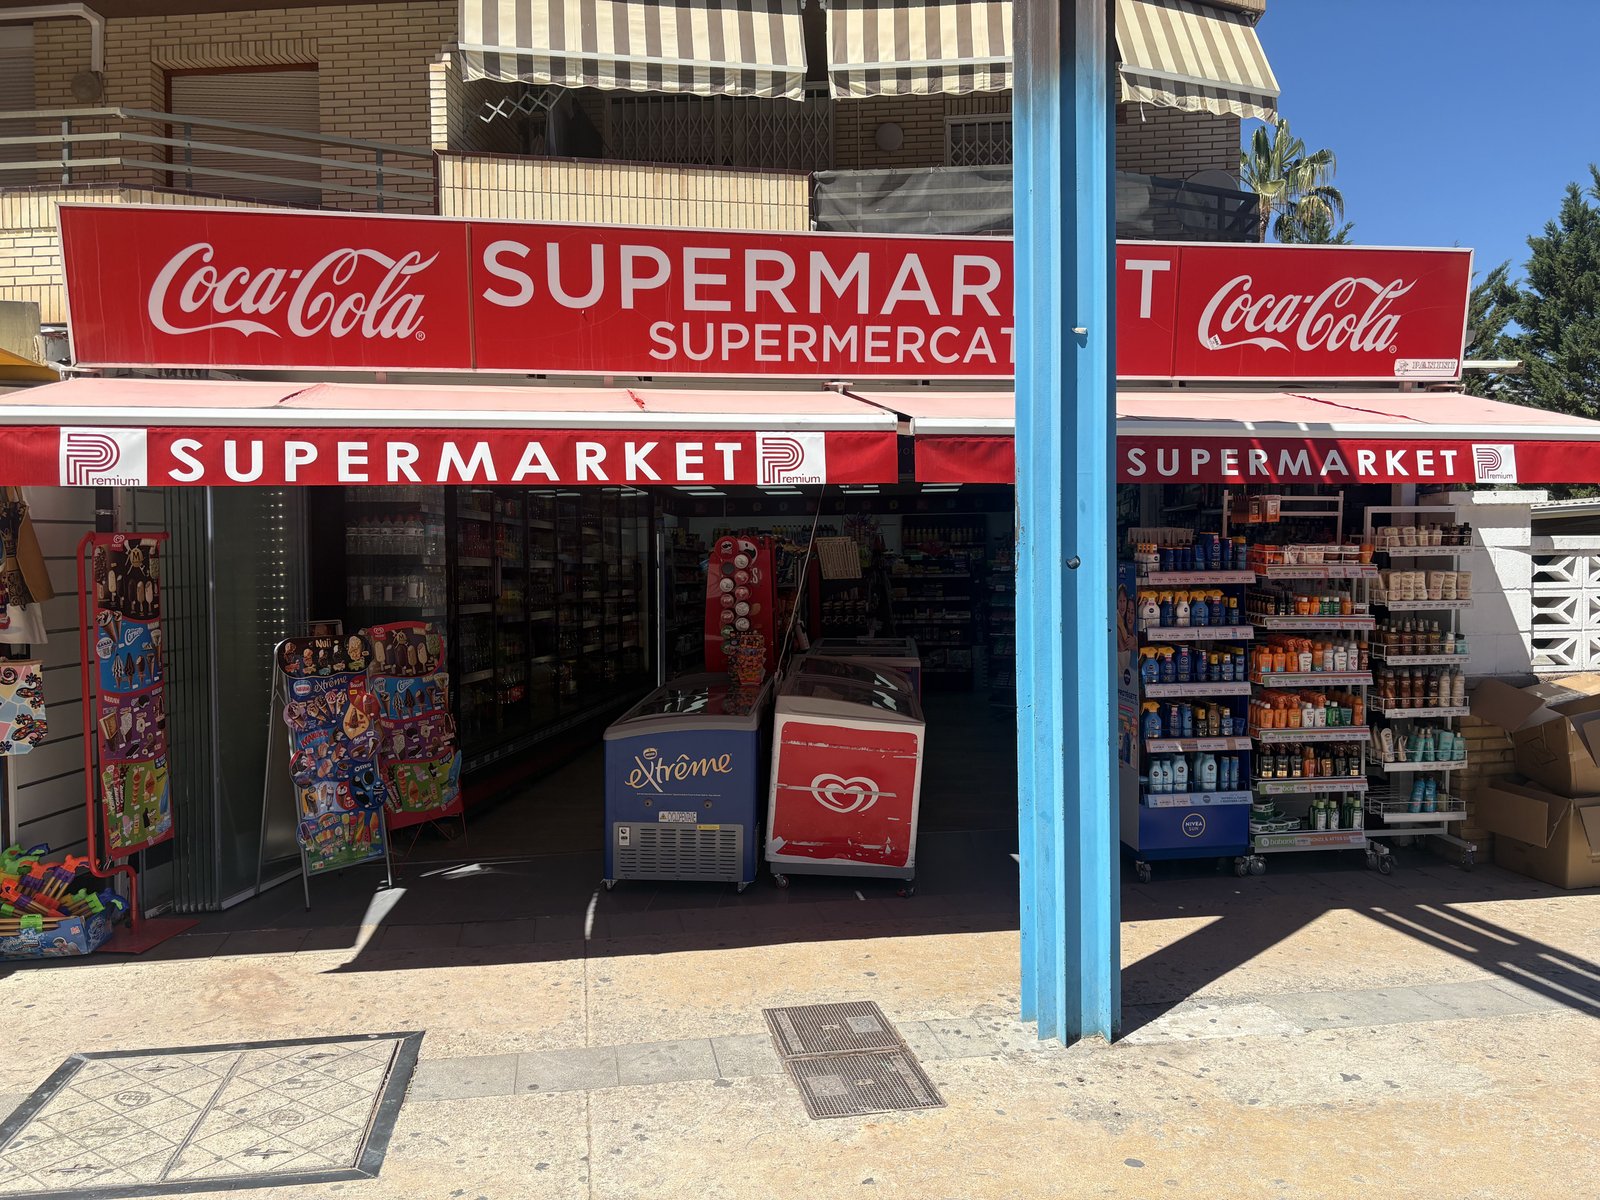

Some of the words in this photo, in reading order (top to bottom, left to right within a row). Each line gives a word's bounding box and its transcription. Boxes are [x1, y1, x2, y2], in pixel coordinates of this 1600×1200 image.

[147, 242, 439, 339] Coca-Cola
[482, 240, 1171, 319] SUPERMART
[1197, 274, 1417, 352] Coca-Cola
[1412, 361, 1456, 369] PANINI
[167, 438, 742, 483] SUPERMARKET
[1126, 447, 1458, 477] SUPERMARKET
